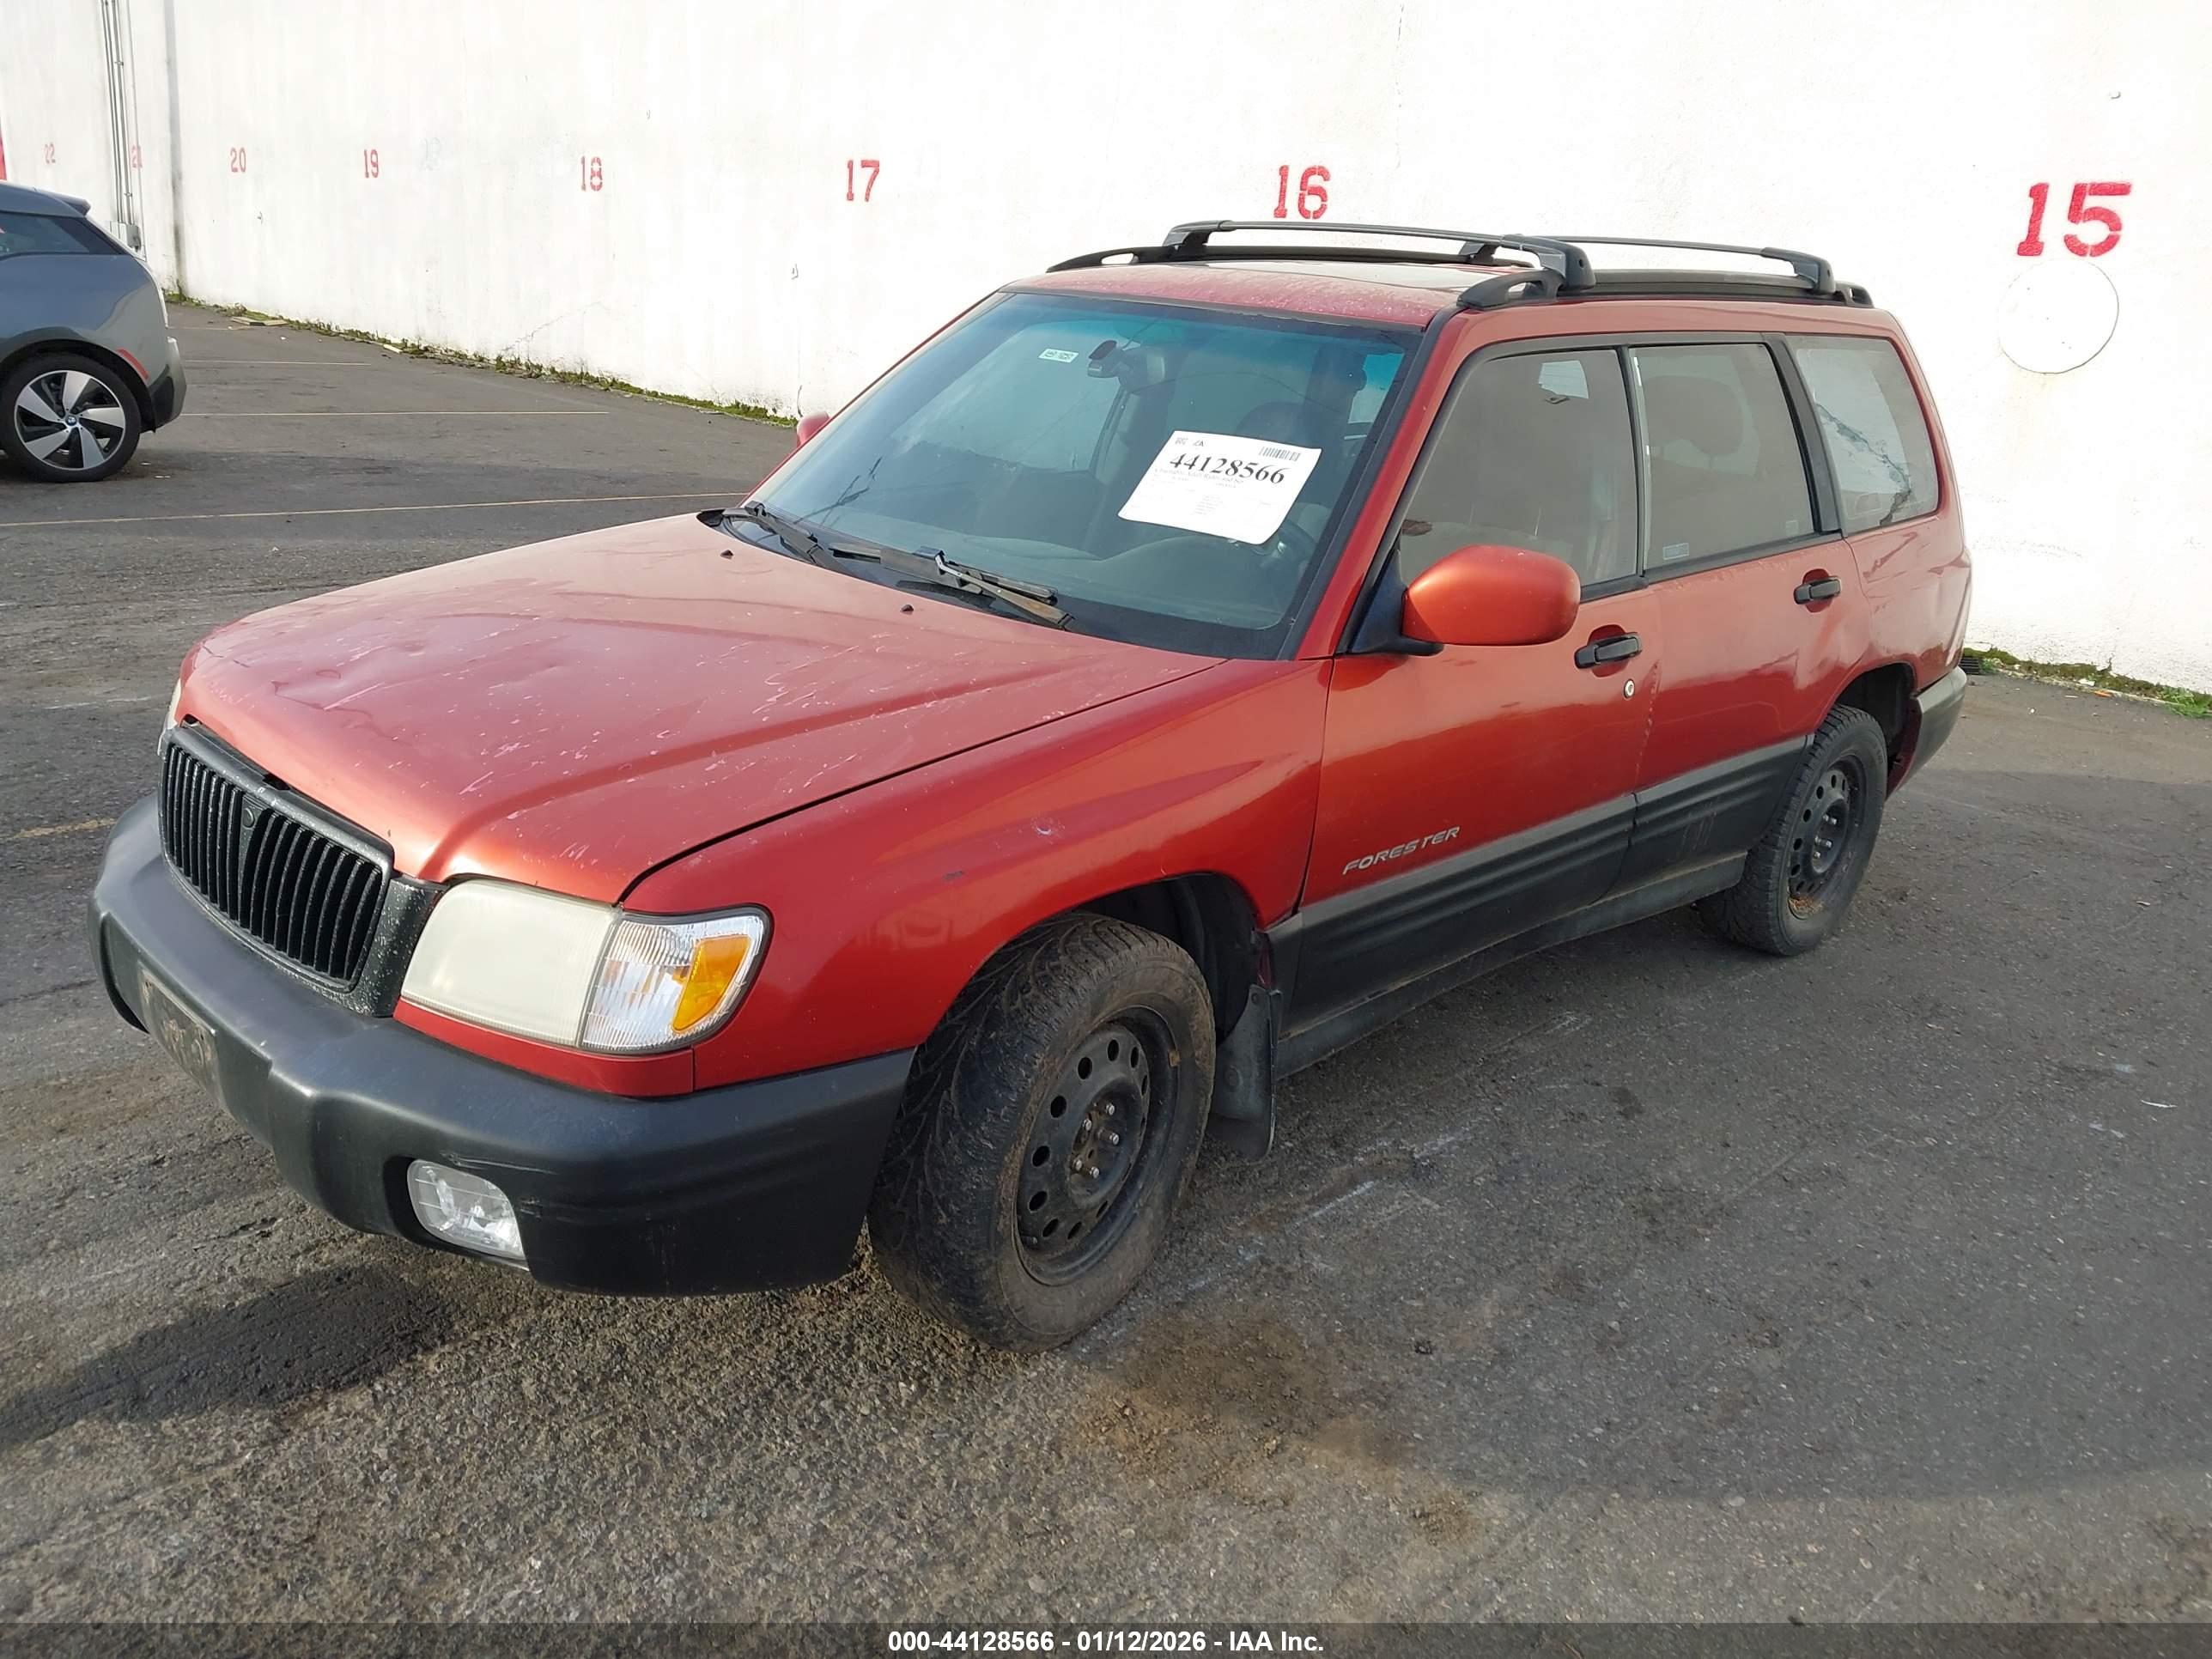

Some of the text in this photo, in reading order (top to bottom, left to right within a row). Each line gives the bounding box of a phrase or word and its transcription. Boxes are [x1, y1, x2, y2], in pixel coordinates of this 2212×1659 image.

[43, 143, 56, 164] 22
[229, 147, 246, 173] 20
[364, 149, 379, 179] 19
[581, 155, 603, 191] 18
[846, 158, 880, 203] 17
[1273, 164, 1332, 220] 16
[2015, 180, 2134, 258] 15
[1170, 453, 1291, 484] 44128566
[1342, 826, 1461, 876] FORESTER
